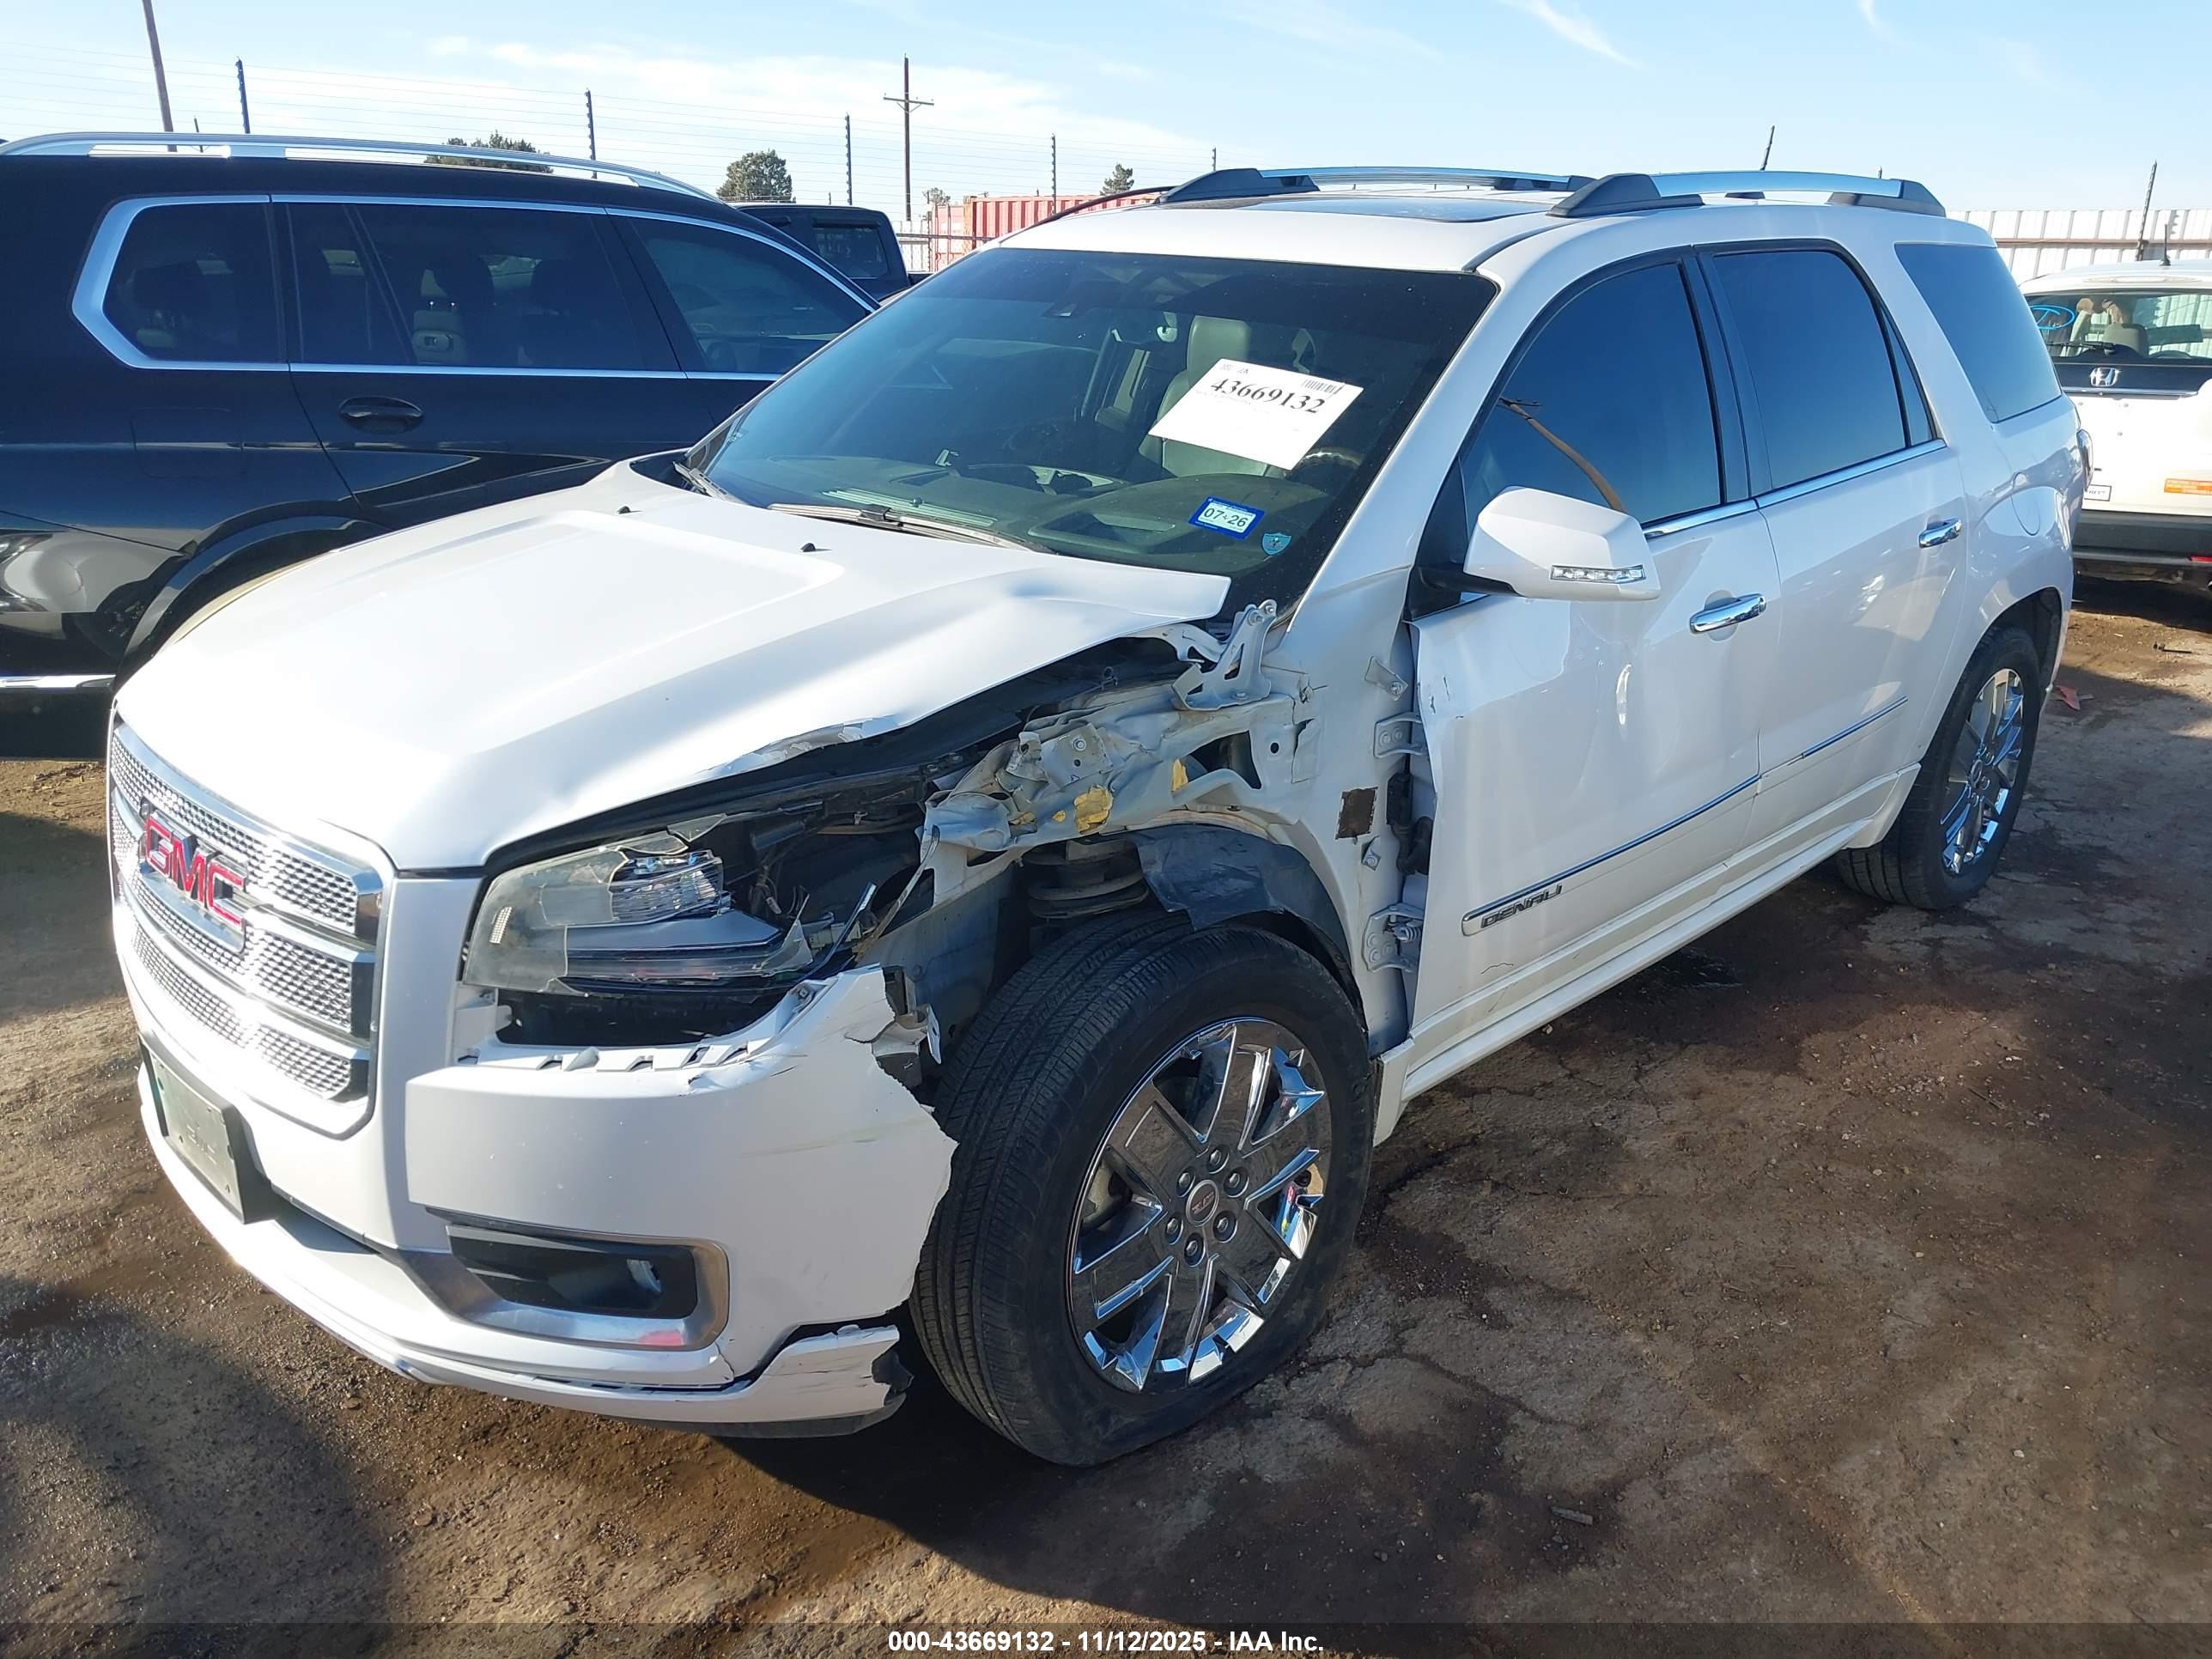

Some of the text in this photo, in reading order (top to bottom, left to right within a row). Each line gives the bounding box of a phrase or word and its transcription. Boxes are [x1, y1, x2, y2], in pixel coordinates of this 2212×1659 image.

[1210, 378, 1326, 414] 43669132
[144, 810, 247, 925] GMC
[1480, 884, 1563, 928] DENALI
